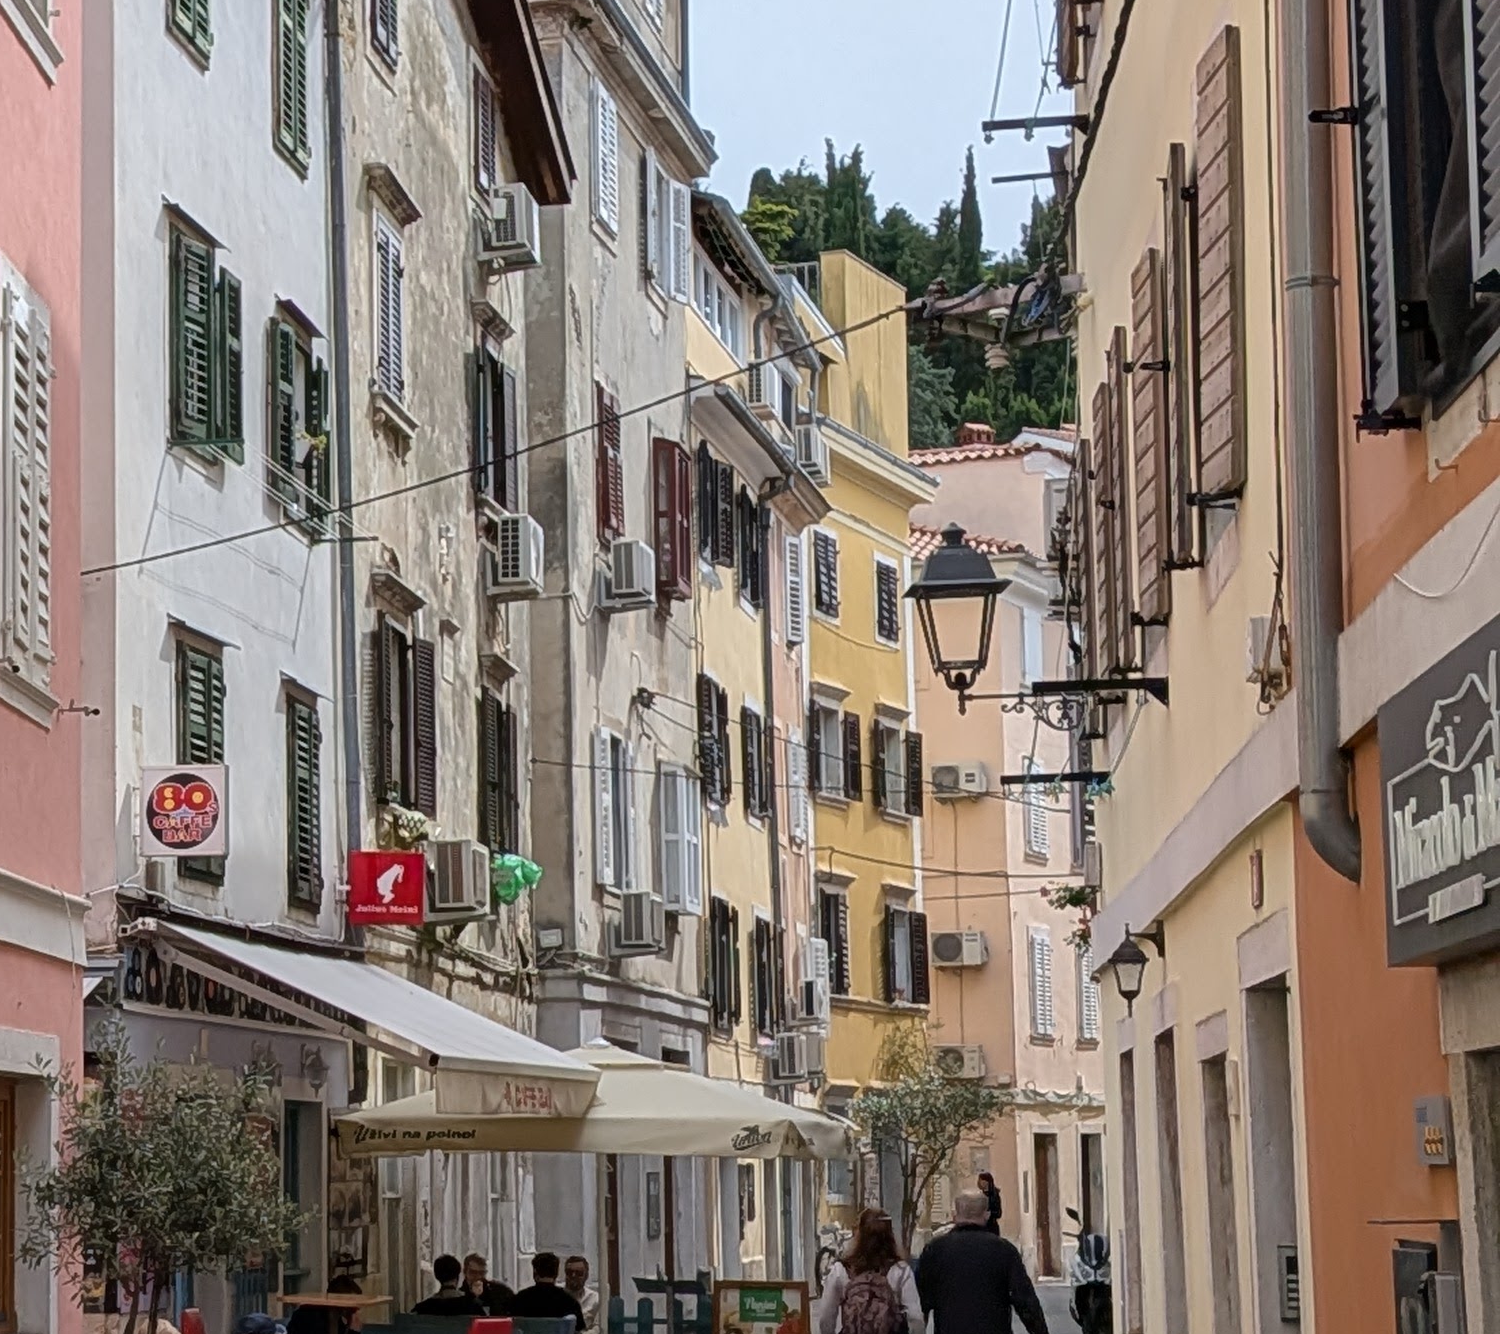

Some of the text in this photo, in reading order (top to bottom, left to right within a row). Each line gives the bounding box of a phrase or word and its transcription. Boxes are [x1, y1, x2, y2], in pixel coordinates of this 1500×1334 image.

[153, 814, 212, 829] CAFFE
[162, 828, 202, 842] BAR
[402, 1130, 421, 1139] na
